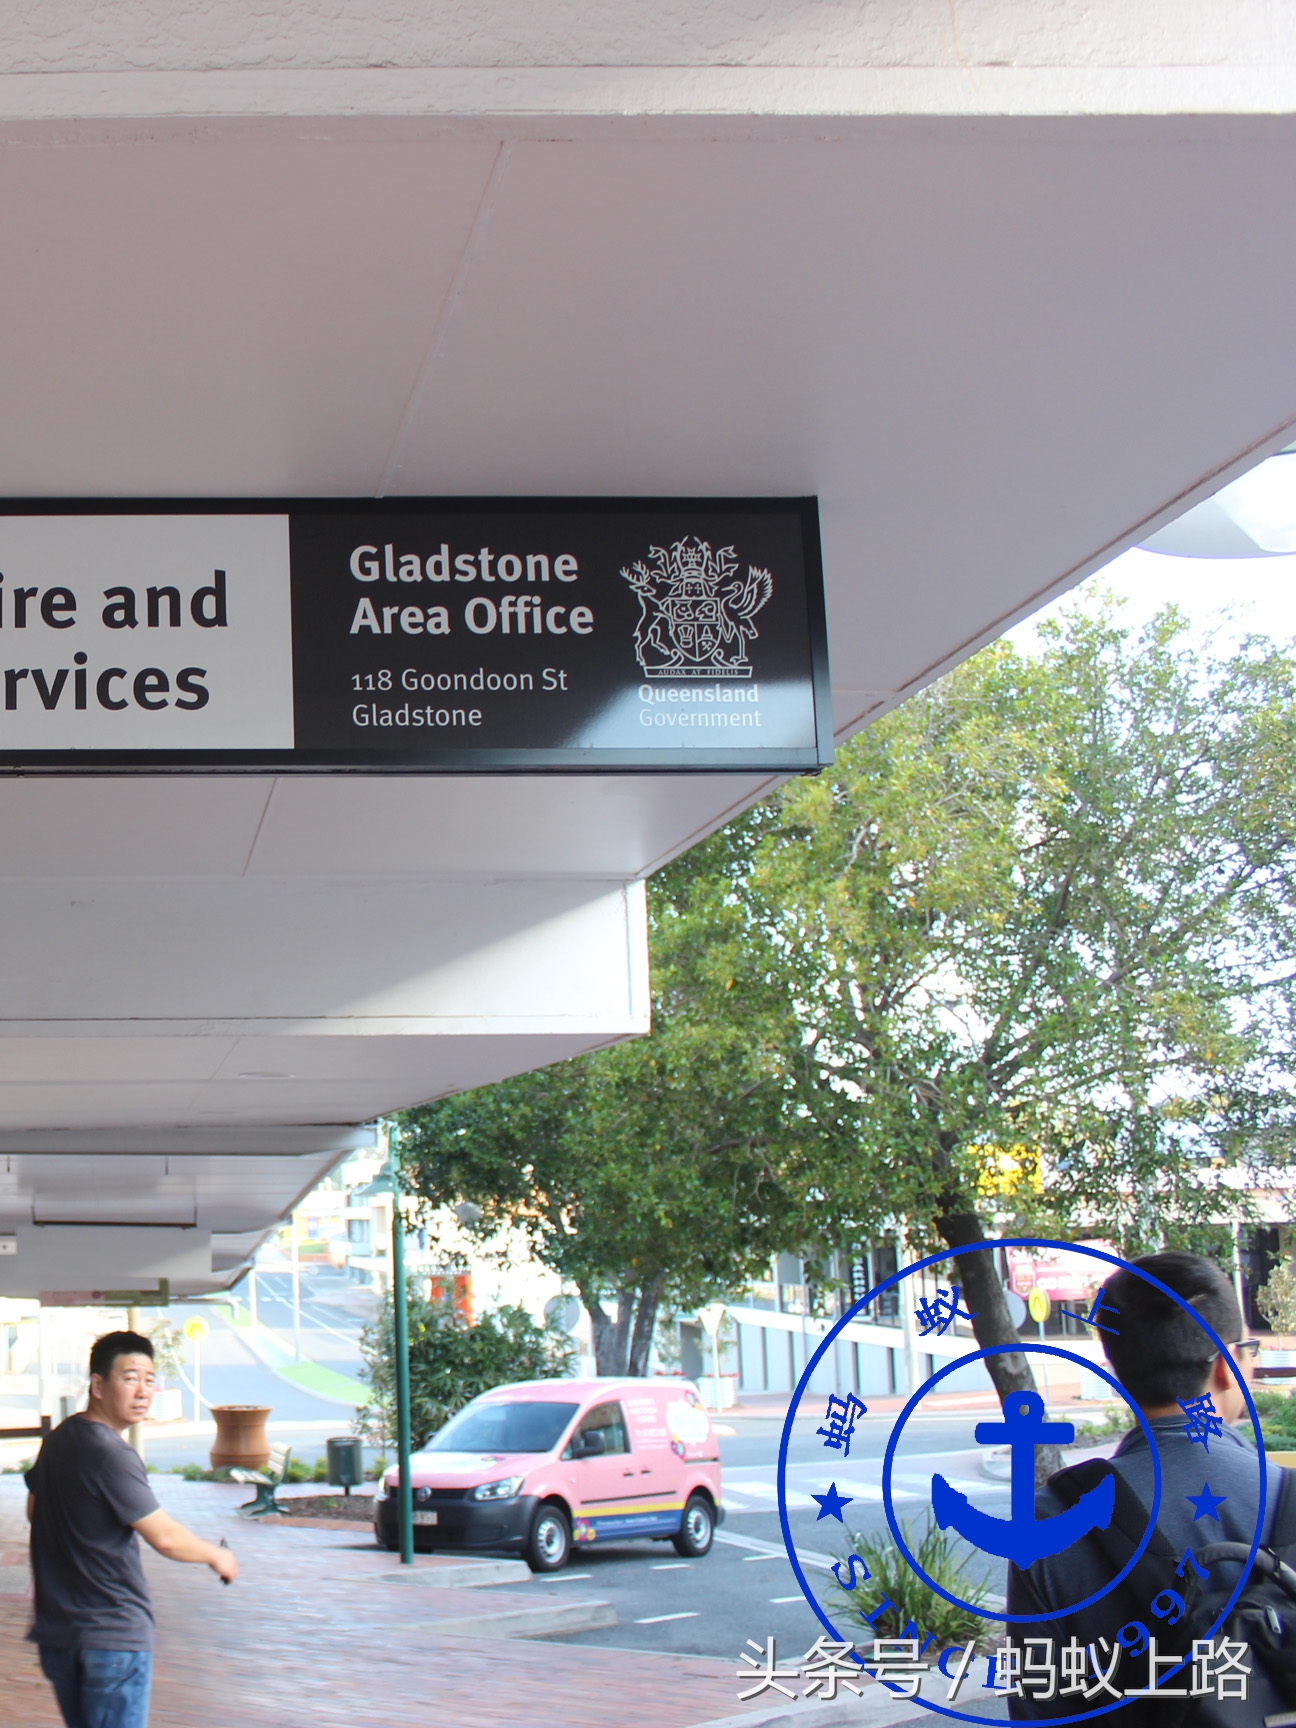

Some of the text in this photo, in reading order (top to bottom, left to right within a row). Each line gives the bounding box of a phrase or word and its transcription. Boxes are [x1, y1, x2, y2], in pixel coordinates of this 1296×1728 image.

[349, 543, 578, 583] Gladstone
[101, 569, 228, 630] and
[349, 595, 594, 635] Area Office
[351, 667, 568, 691] 118 Goondoon St
[638, 683, 759, 705] Queensland
[352, 702, 483, 727] Gladstone
[639, 708, 762, 727] Government
